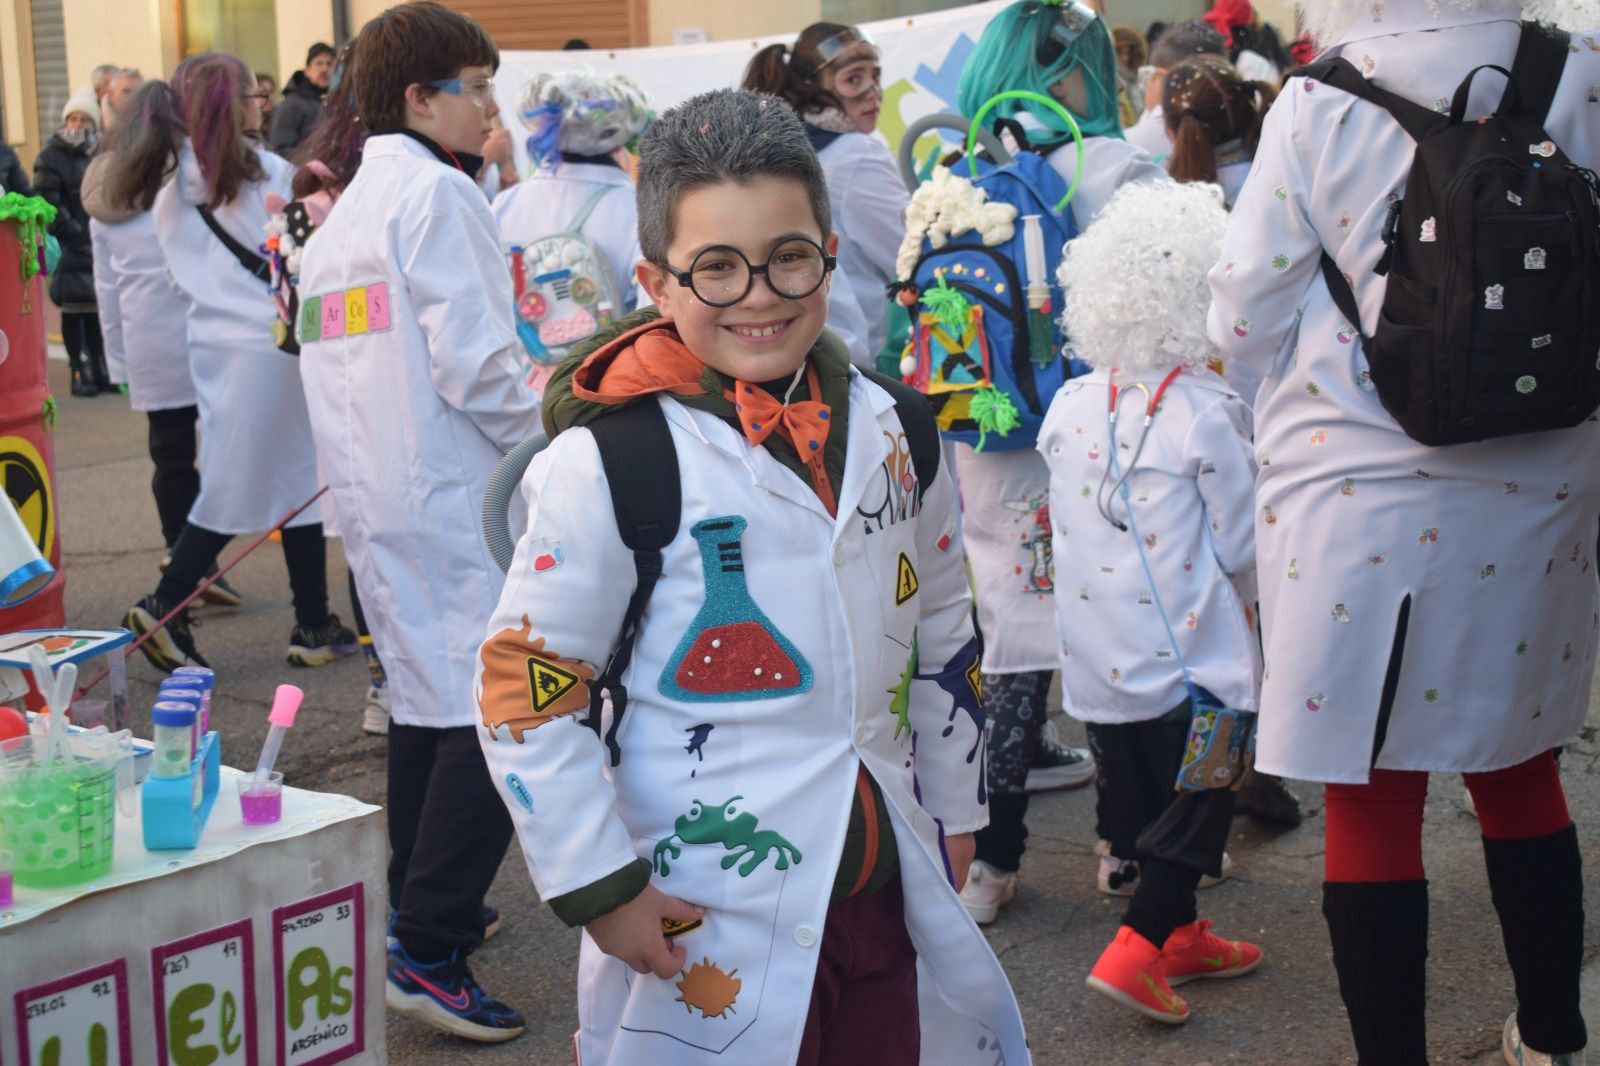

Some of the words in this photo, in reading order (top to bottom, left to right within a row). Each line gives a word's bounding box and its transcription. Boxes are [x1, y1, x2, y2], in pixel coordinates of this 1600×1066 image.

[336, 904, 350, 921] 33
[91, 981, 110, 997] 92
[288, 946, 353, 1031] As
